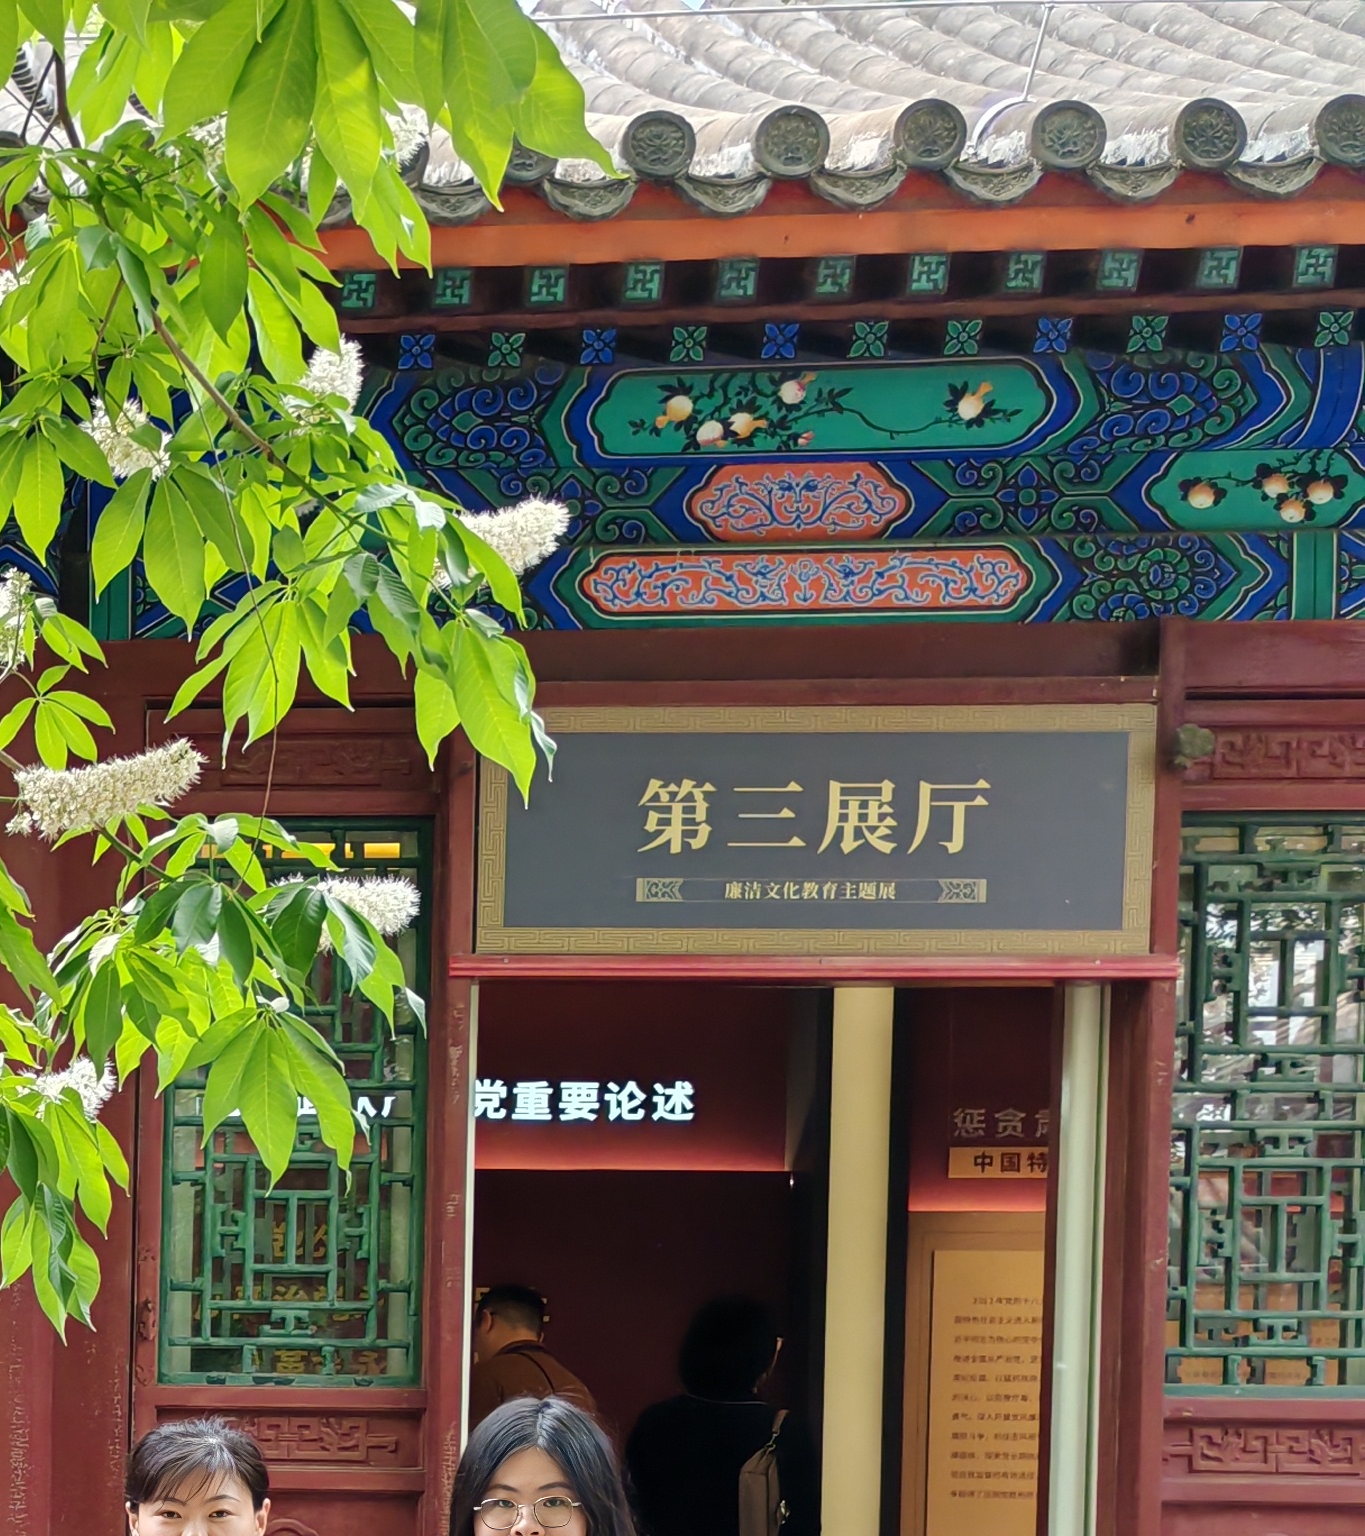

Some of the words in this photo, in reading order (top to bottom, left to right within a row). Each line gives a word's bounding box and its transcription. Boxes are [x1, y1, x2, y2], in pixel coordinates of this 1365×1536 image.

[636, 778, 991, 855] 第三展厅
[725, 881, 897, 900] 廉洁文化教育主题展
[474, 1079, 695, 1121] 党重要论述
